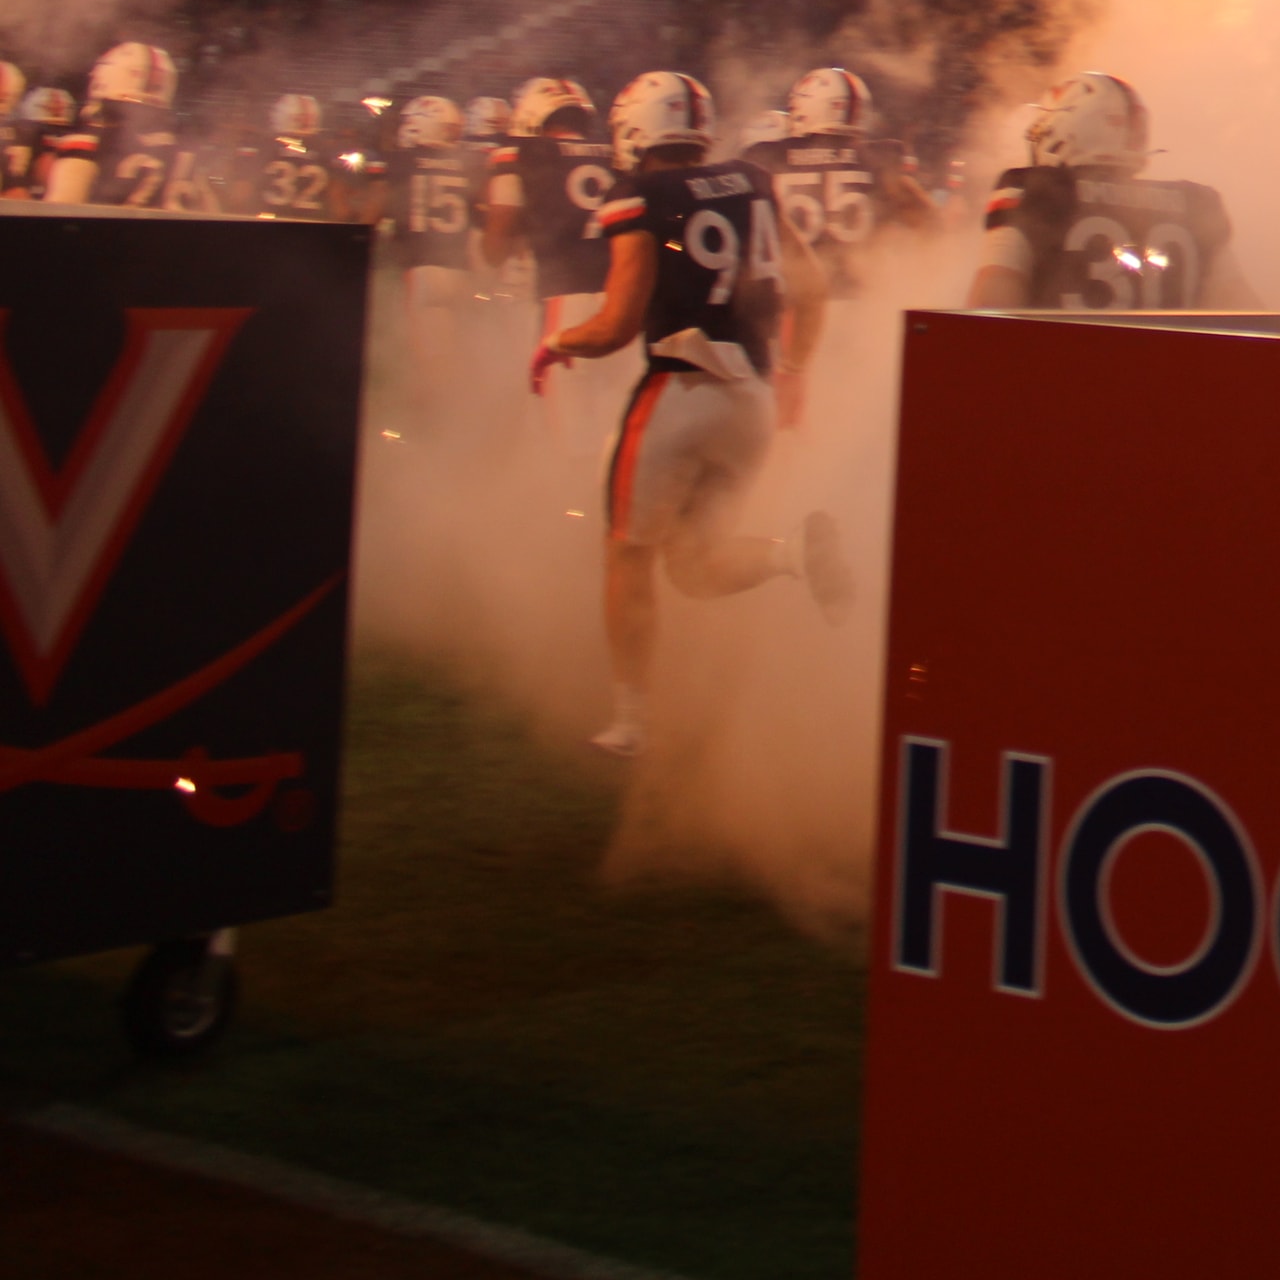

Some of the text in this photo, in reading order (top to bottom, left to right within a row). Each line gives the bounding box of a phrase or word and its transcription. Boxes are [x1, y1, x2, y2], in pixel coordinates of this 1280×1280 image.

[262, 161, 329, 209] 32
[409, 174, 470, 233] 15
[685, 198, 787, 305] 94
